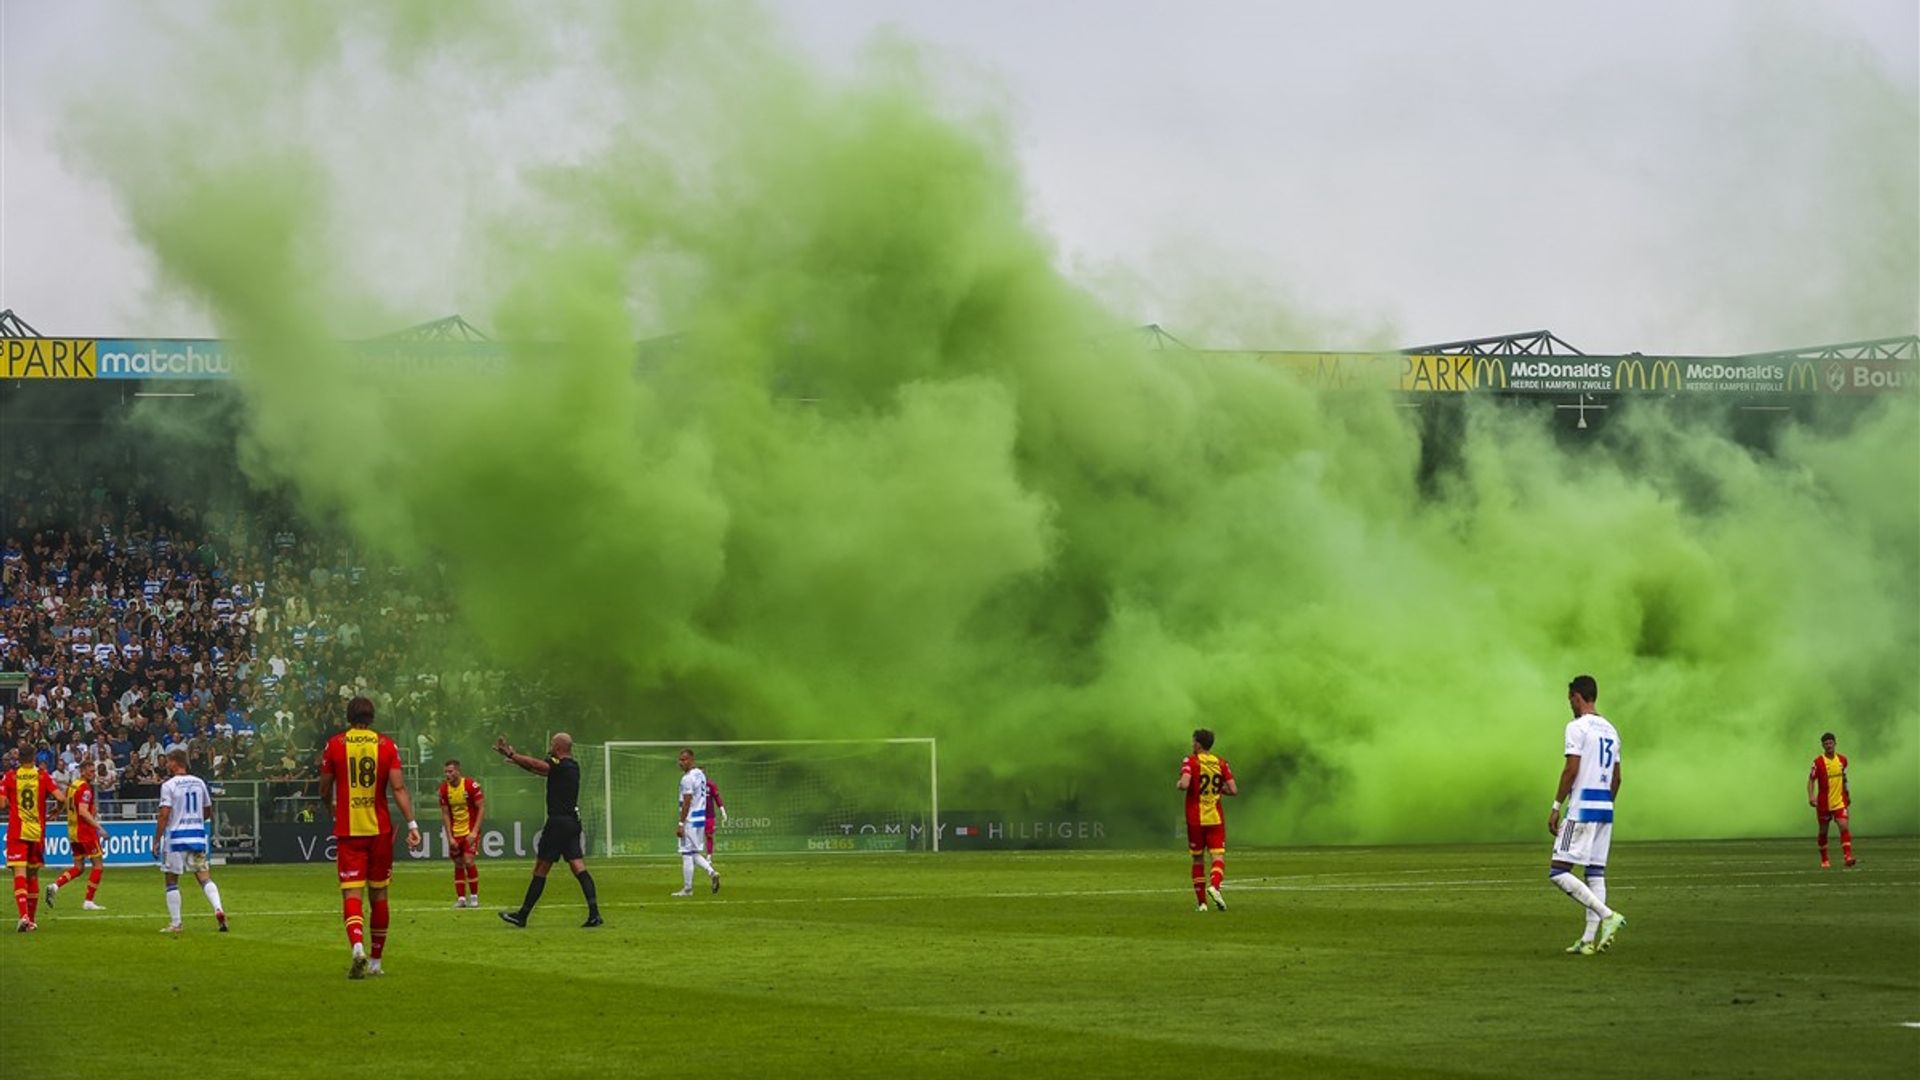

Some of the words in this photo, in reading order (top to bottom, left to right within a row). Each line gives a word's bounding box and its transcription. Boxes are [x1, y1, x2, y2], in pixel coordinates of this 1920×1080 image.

[1511, 362, 1612, 378] McDonald's
[1686, 364, 1784, 380] McDonald's
[1511, 380, 1539, 390] HEERDE
[1546, 380, 1577, 390] KAMPEN
[1582, 380, 1612, 390] ZWOLLE
[1720, 382, 1750, 392] KAMPEN
[1755, 382, 1784, 392] ZWOLLE
[1599, 736, 1614, 769] 13
[348, 756, 376, 788] 18
[1200, 773, 1222, 795] 29
[21, 788, 35, 810] 8
[185, 791, 198, 813] 11
[721, 817, 771, 830] LEGEND
[840, 823, 947, 841] TOMMY
[988, 822, 1105, 840] HILFIGER
[807, 838, 854, 850] bet365
